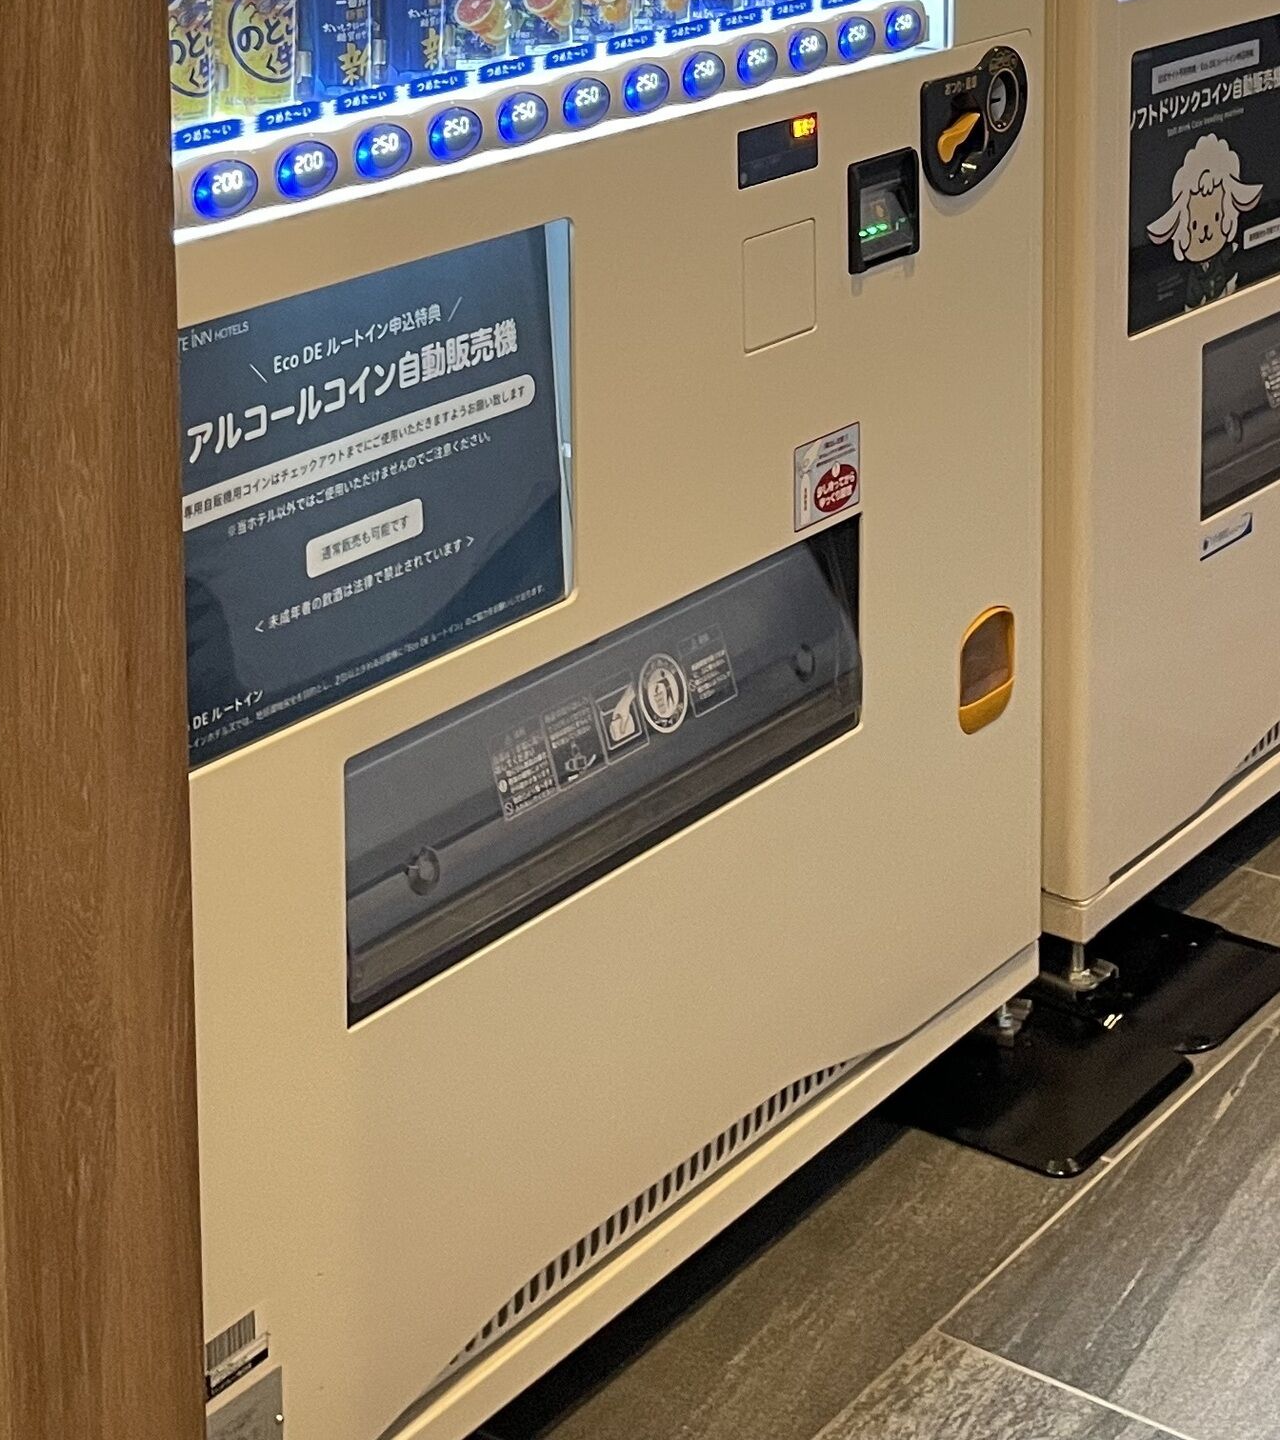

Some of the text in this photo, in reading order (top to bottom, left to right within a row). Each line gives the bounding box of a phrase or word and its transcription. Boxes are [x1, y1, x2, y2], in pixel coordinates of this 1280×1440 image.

[895, 13, 913, 31] 250
[848, 24, 866, 42] 250
[799, 35, 819, 54] 250
[747, 47, 767, 66] 250
[694, 59, 715, 79] 250
[636, 72, 659, 92] 250
[575, 86, 600, 106] 250
[512, 100, 536, 122] 250
[443, 116, 469, 138] 250
[371, 132, 400, 155] 250
[293, 151, 323, 175] 200
[211, 169, 243, 195] 200
[214, 321, 249, 341] HOTELS
[273, 303, 441, 373] Eco DE ルートイン申込特典
[187, 318, 518, 463] アルコールコイン自動販売機
[193, 689, 263, 730] DE ルートイン
